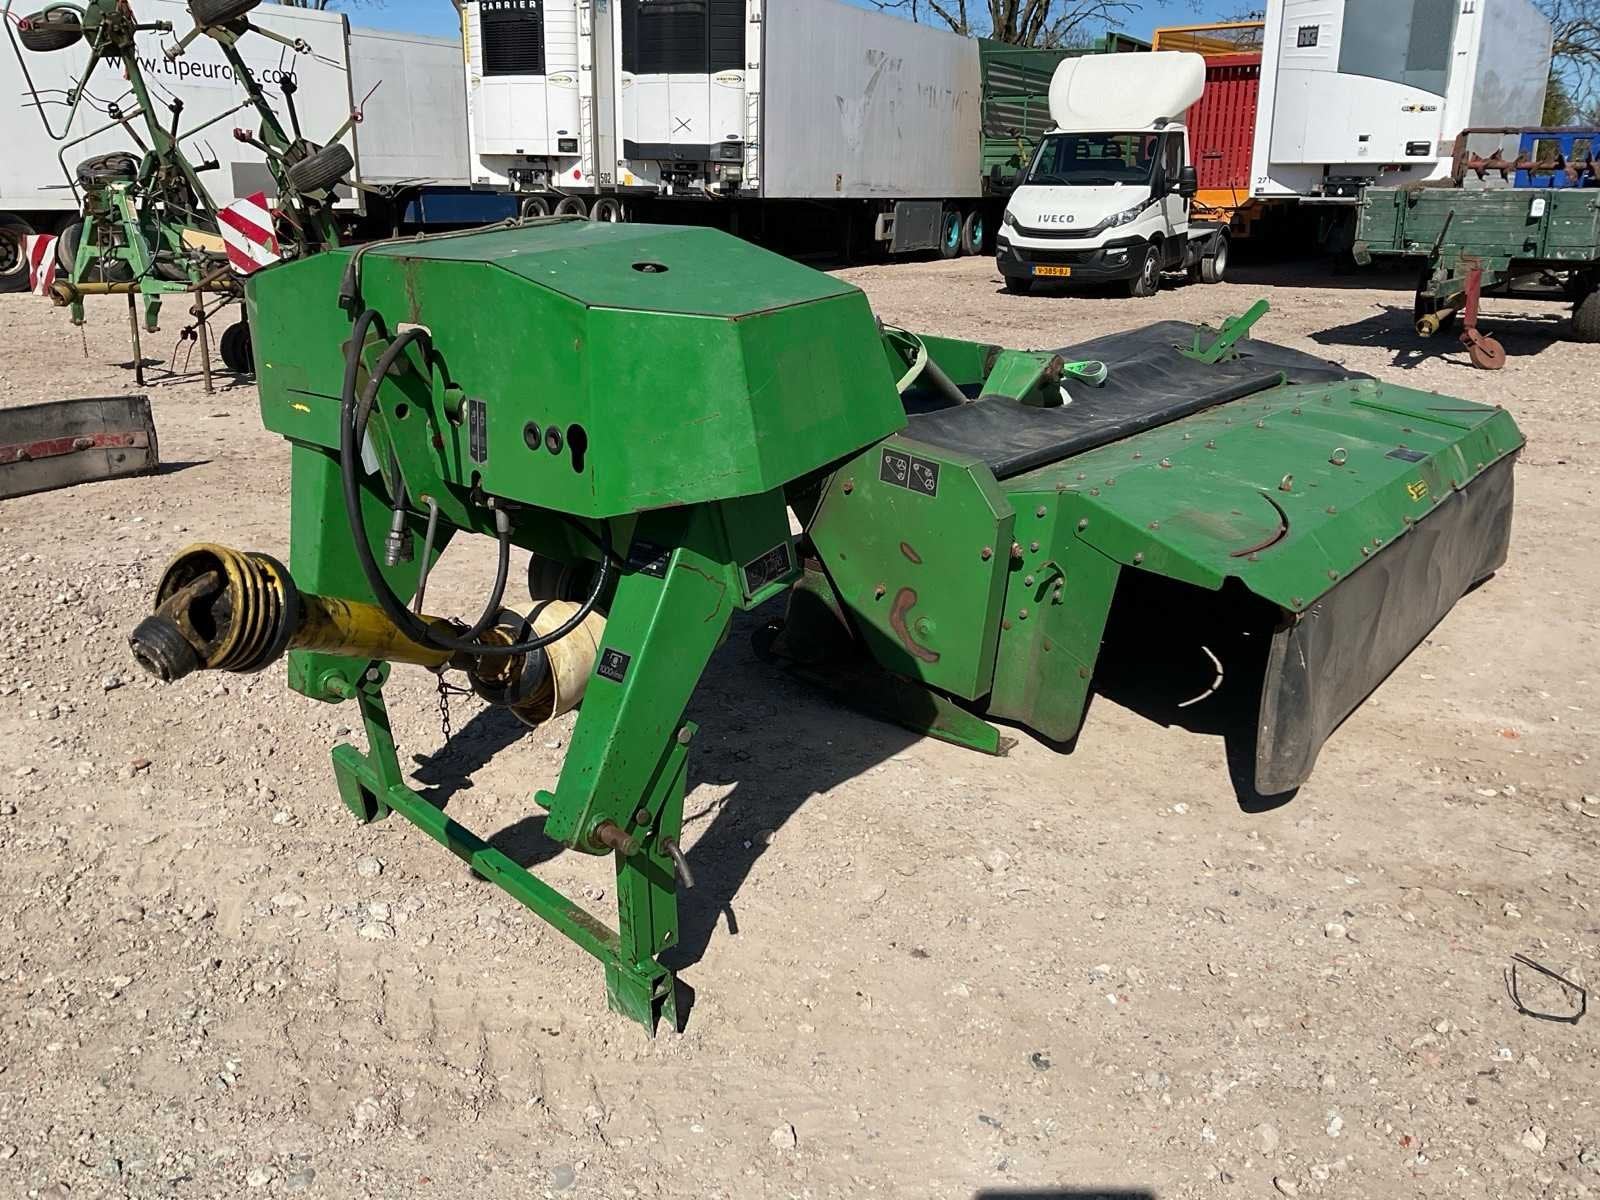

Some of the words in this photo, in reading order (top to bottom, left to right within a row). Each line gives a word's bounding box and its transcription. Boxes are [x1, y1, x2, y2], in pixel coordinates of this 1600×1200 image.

[481, 0, 537, 11] CARRIER
[105, 56, 298, 86] ww.tipeuro.com
[1038, 214, 1075, 223] IVECO
